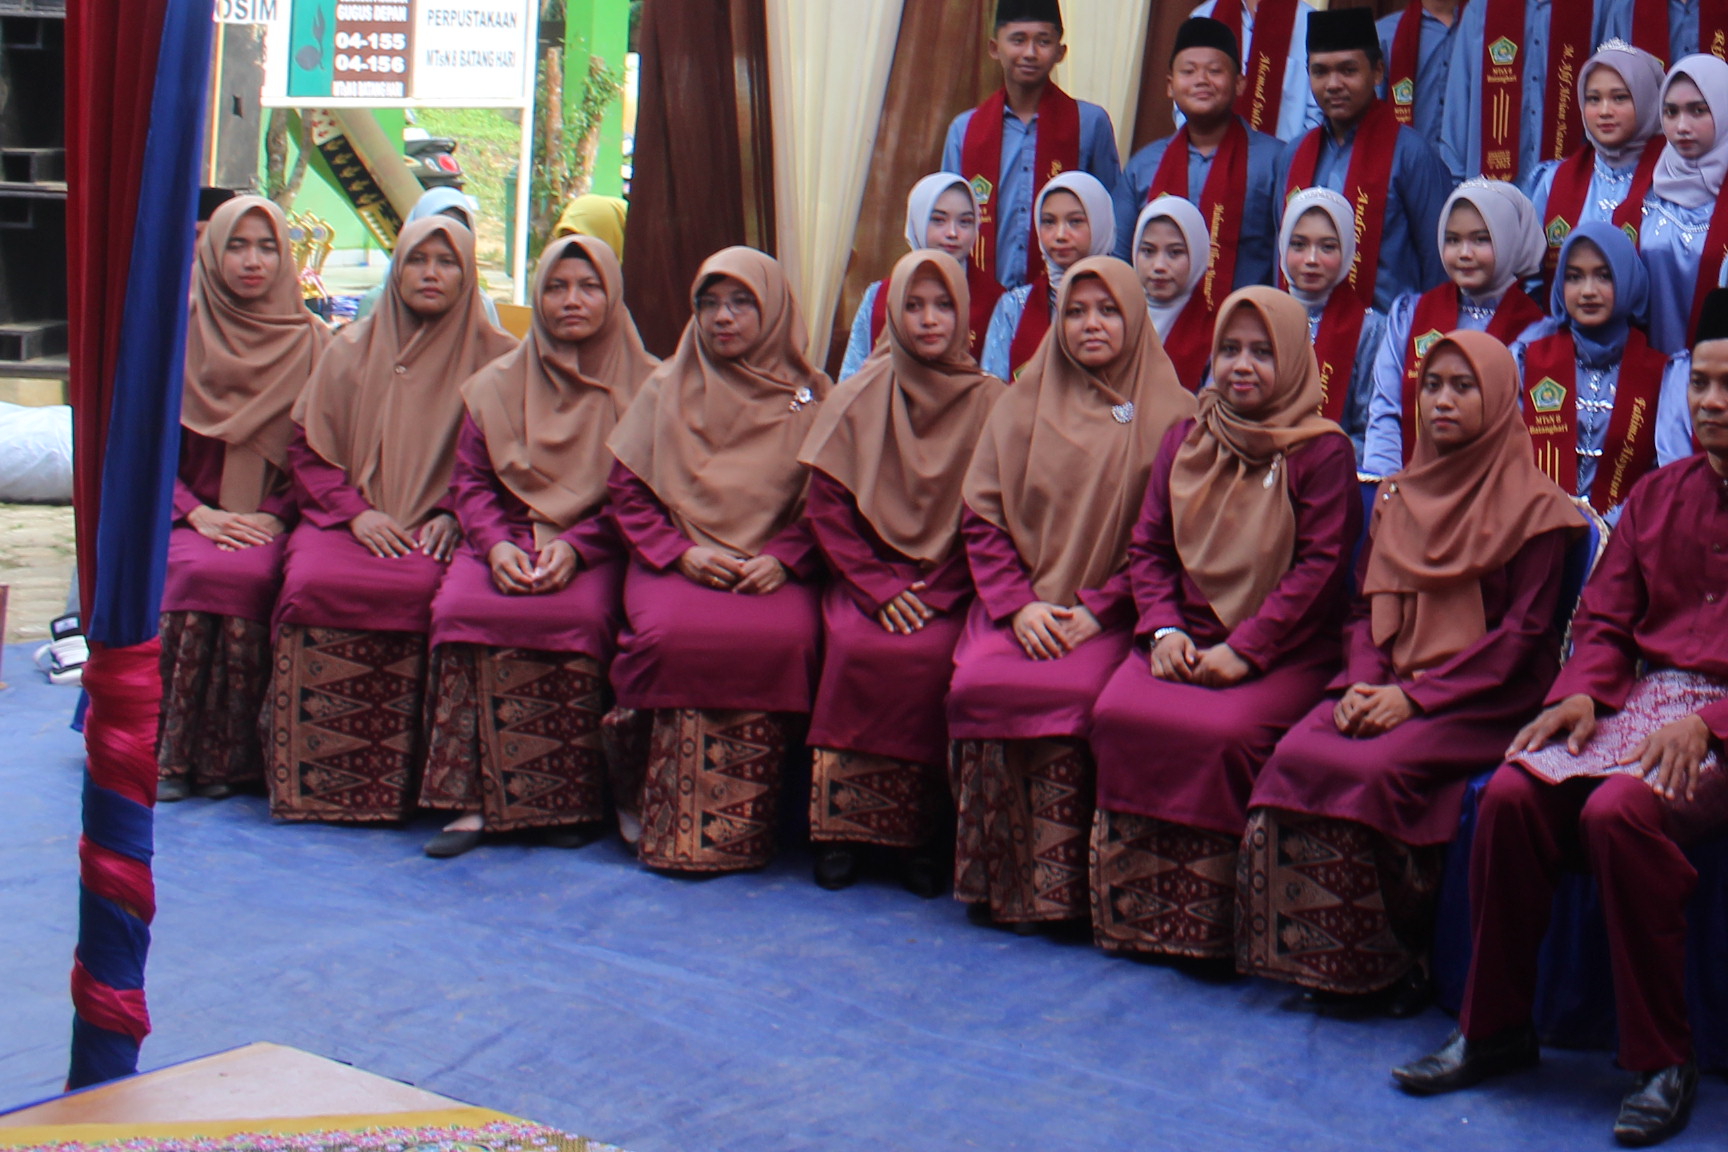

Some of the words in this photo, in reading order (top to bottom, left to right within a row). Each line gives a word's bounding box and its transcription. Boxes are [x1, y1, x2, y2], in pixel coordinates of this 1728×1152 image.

[337, 4, 373, 22] GUGUS
[427, 9, 518, 29] PERPUSTAKAAN
[335, 32, 406, 50] 04-155
[335, 53, 405, 73] 04-156
[460, 50, 495, 68] BATANG
[496, 50, 516, 68] HARI
